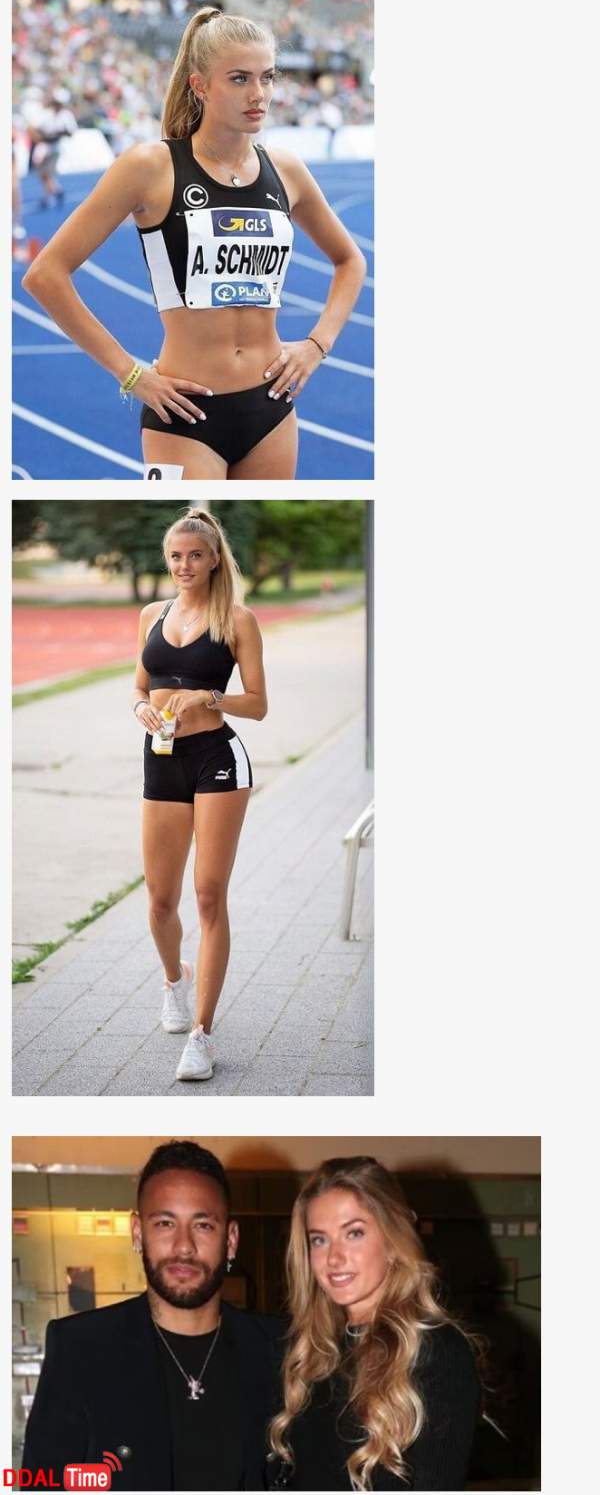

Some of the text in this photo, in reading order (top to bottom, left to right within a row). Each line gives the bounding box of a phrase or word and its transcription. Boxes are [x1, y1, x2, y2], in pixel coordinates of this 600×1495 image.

[186, 187, 205, 206] C
[245, 218, 268, 232] GLS
[191, 244, 290, 277] A. SCHMIDT
